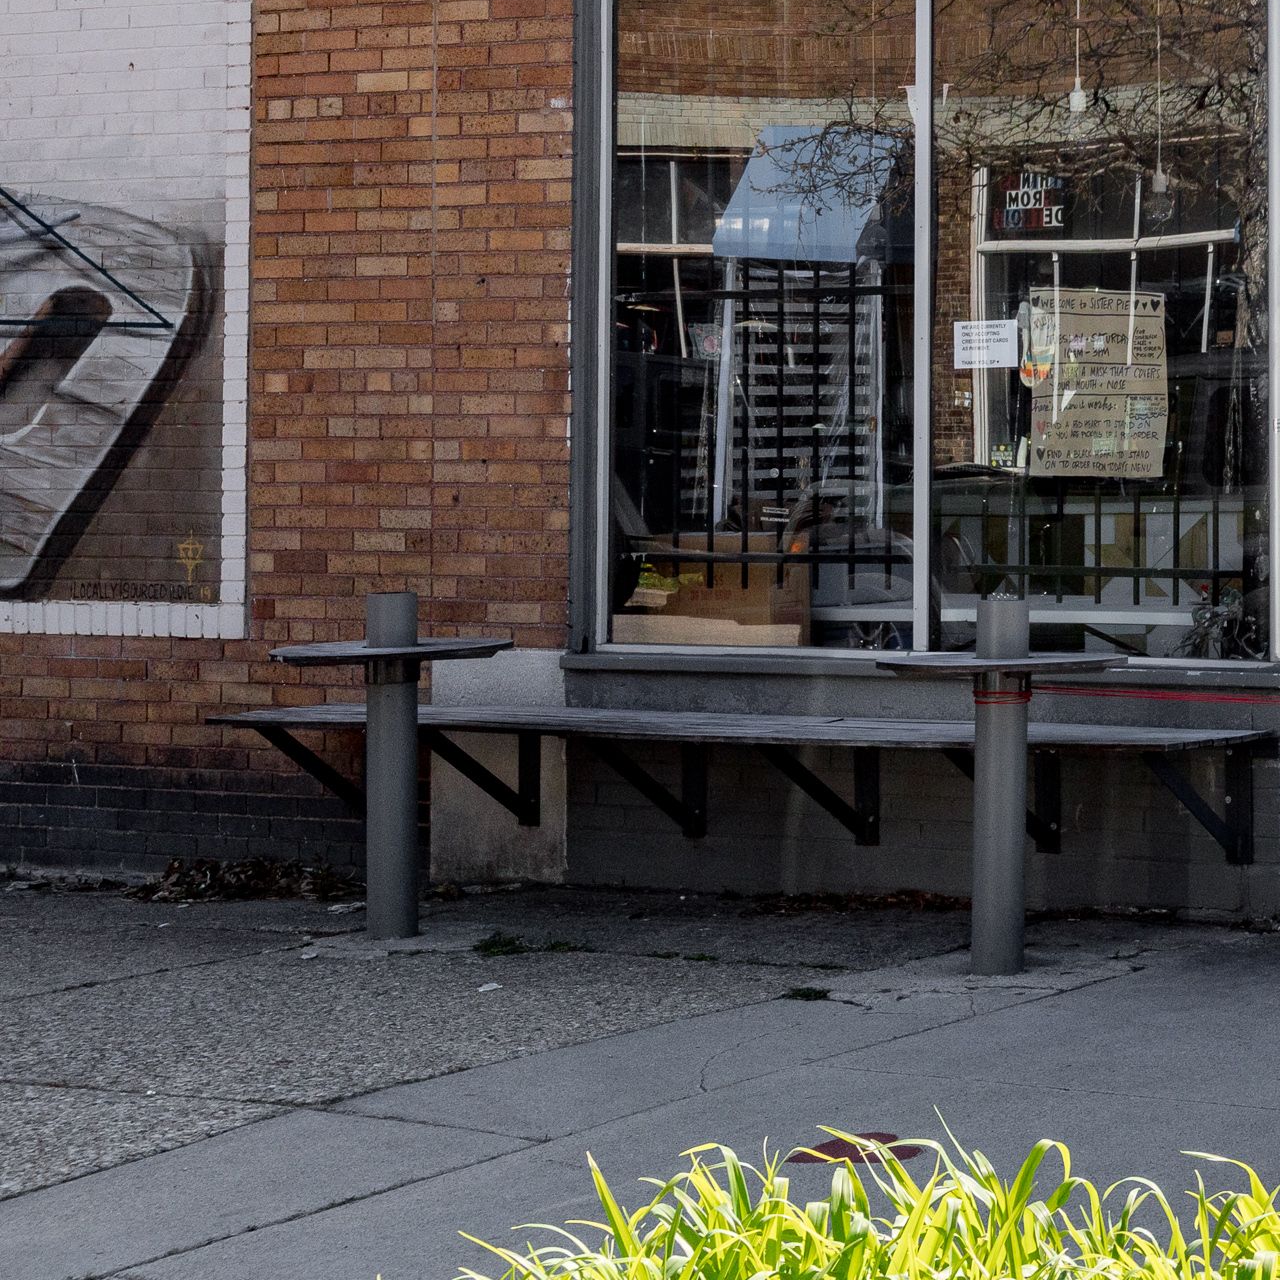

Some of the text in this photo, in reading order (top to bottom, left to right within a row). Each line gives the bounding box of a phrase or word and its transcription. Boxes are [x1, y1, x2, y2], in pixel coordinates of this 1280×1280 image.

[1089, 297, 1114, 310] SISTER
[1116, 298, 1131, 312] PIE
[1110, 366, 1130, 377] THAT
[1134, 367, 1160, 379] COVERS
[1107, 379, 1126, 390] NOSE
[1128, 450, 1150, 459] STAND
[1045, 461, 1056, 470] ON
[1059, 460, 1070, 468] TO
